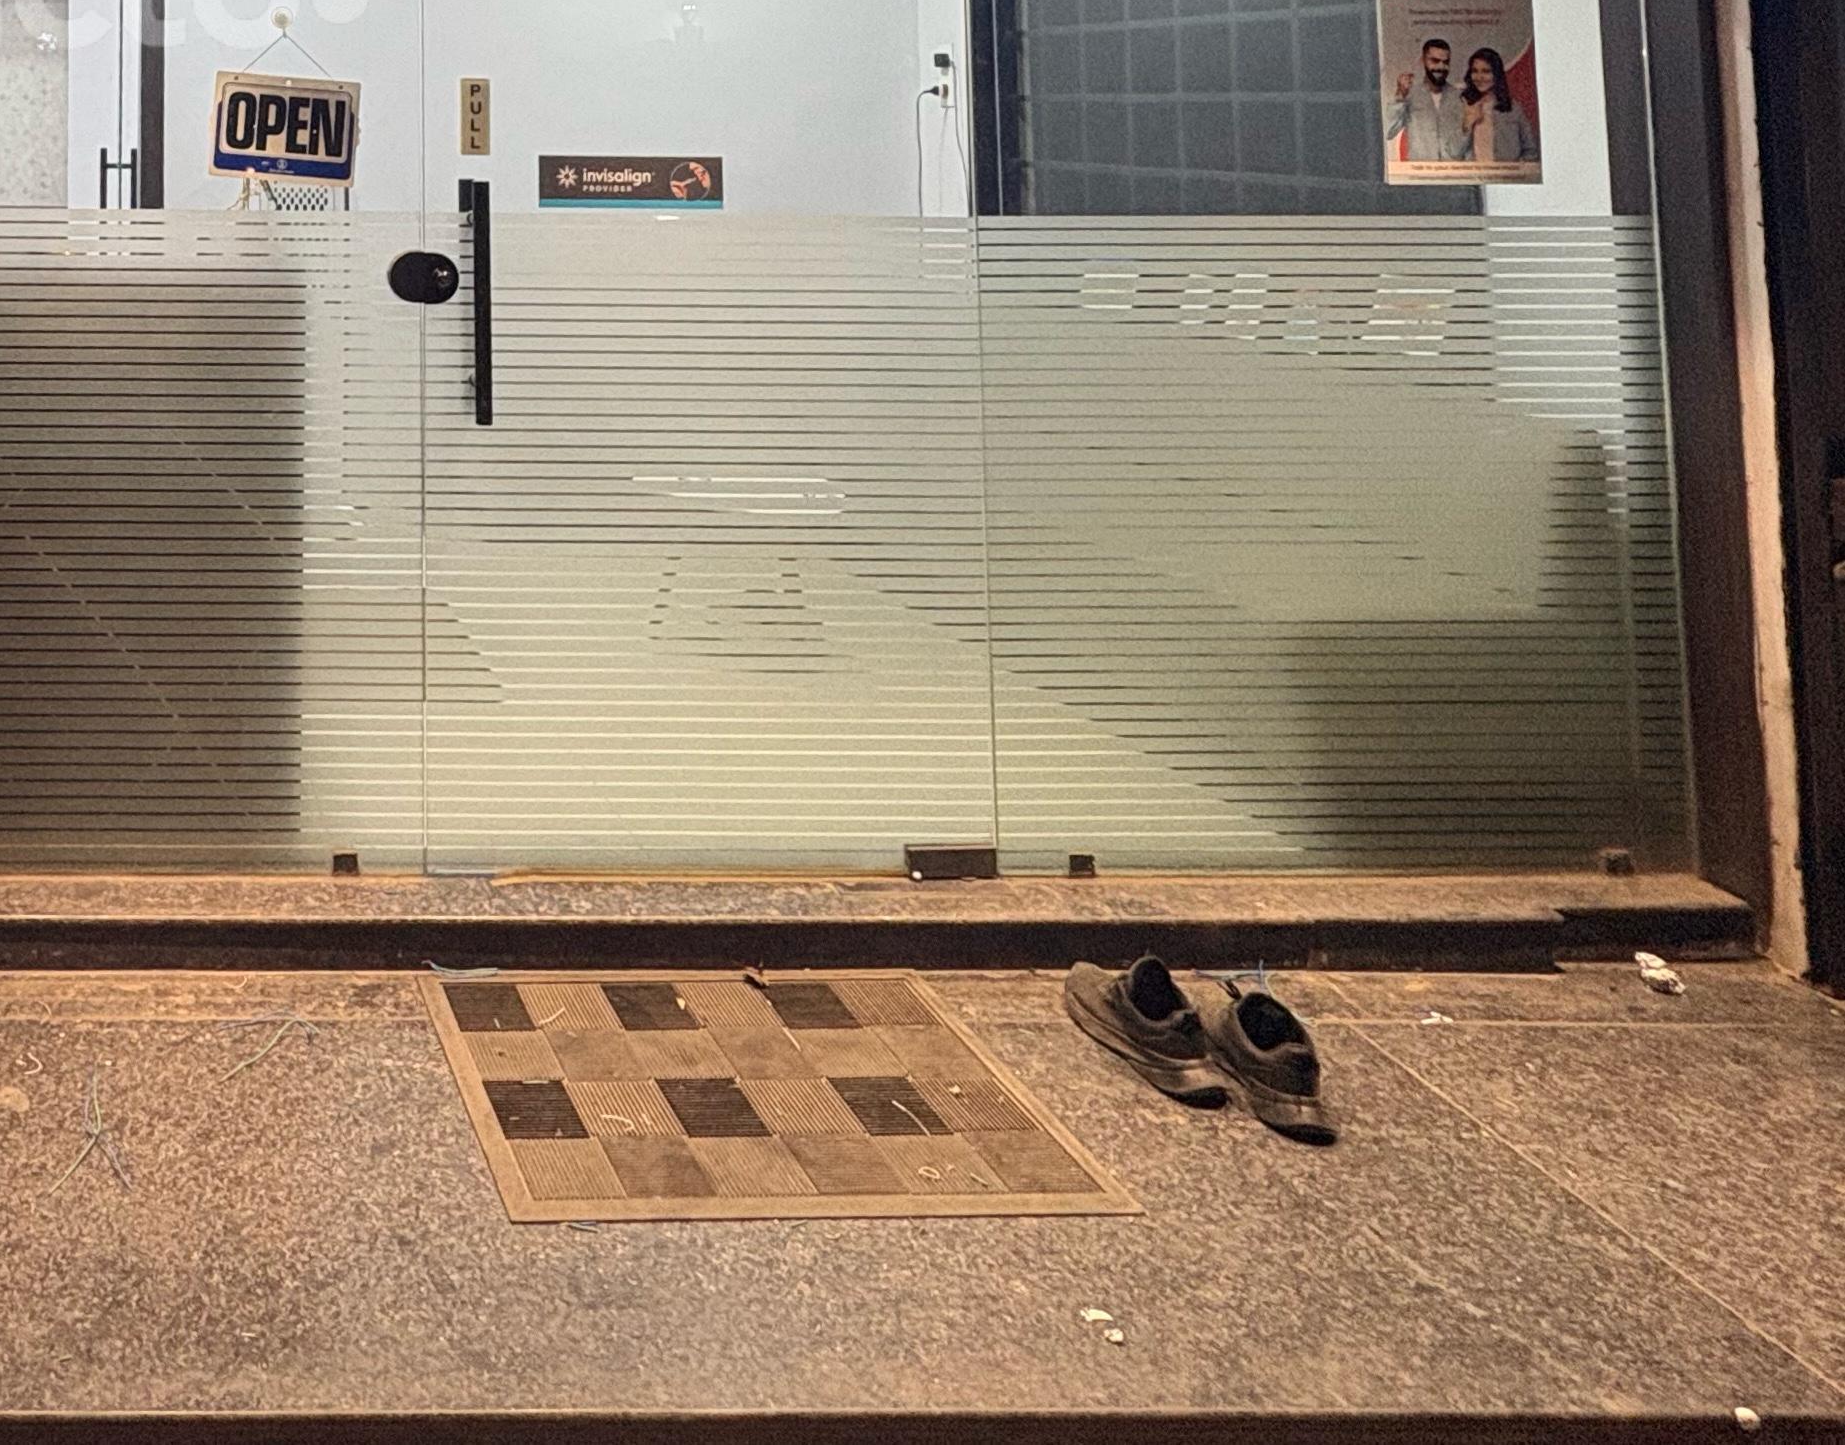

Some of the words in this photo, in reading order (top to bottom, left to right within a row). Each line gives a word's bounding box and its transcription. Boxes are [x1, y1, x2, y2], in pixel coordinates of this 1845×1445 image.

[225, 91, 346, 158] OPEN
[469, 83, 482, 150] PULL
[582, 167, 652, 187] invisalign
